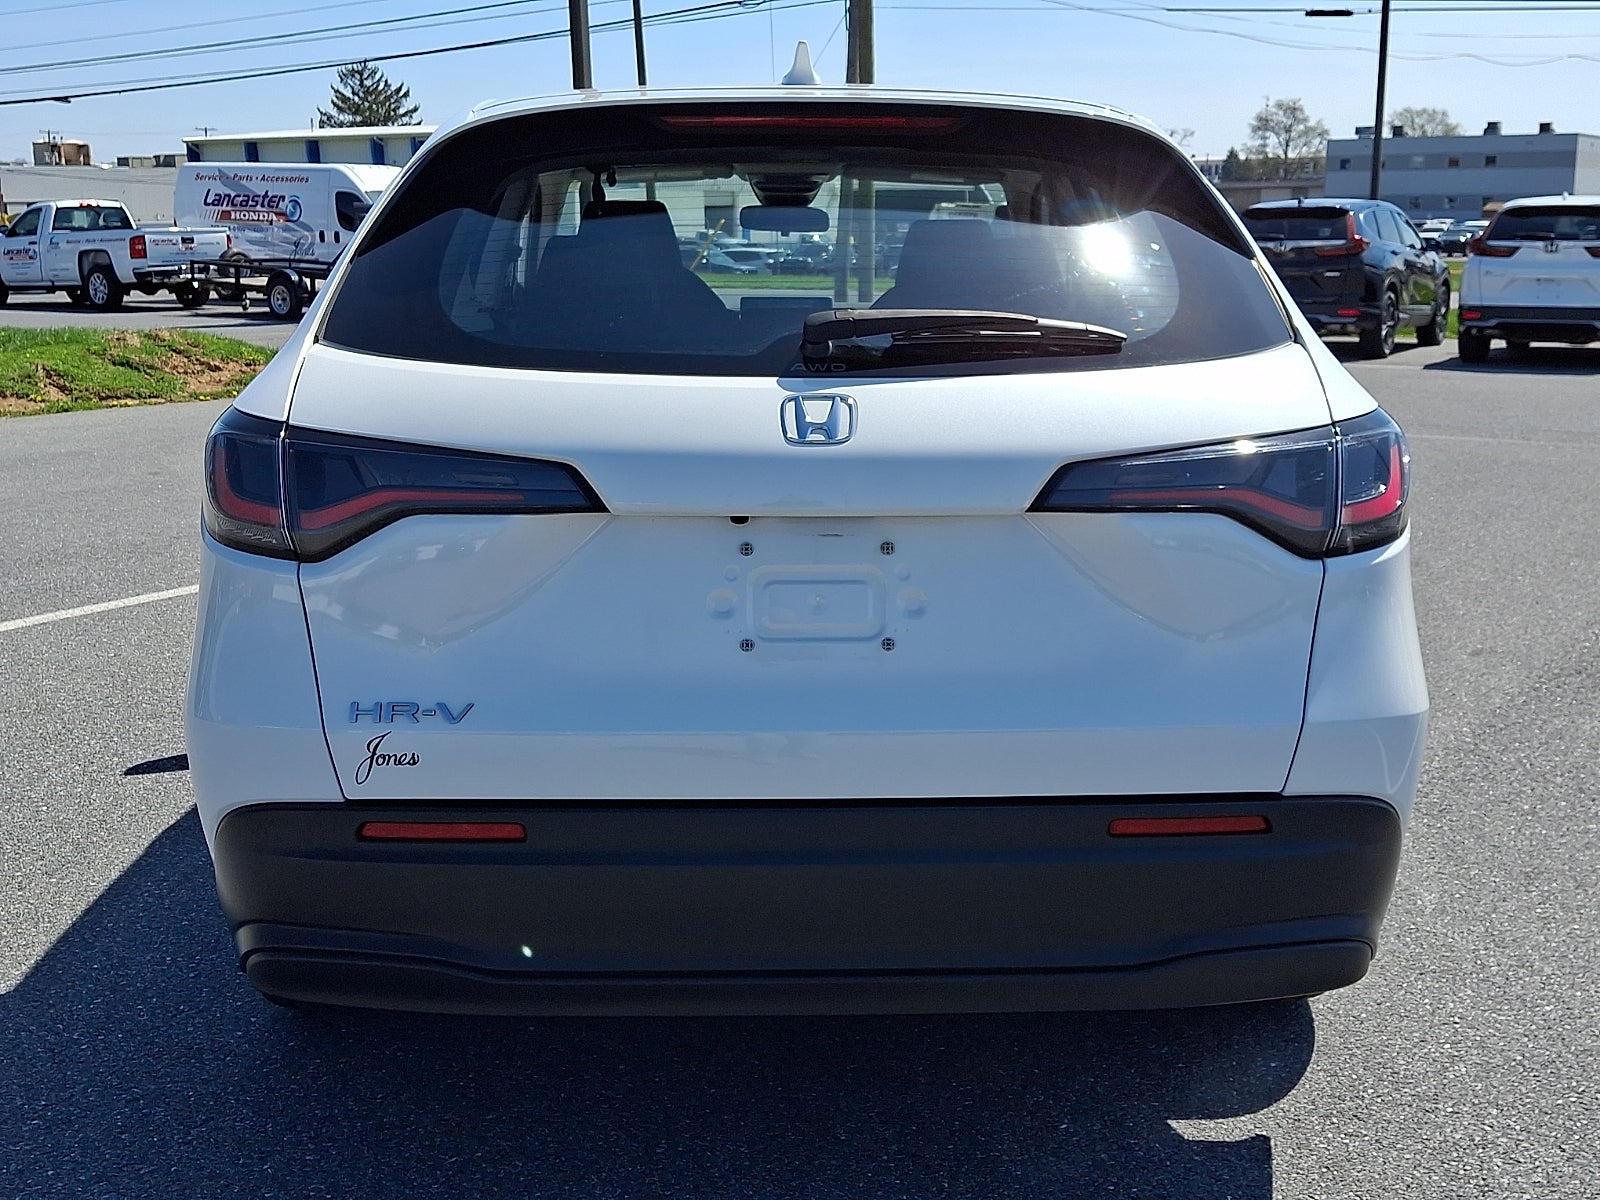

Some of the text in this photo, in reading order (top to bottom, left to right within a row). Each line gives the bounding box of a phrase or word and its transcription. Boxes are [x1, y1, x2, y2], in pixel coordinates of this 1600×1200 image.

[194, 171, 310, 184] Service Parts Accessories
[203, 188, 286, 210] Lancaster
[230, 210, 278, 222] HONDA
[790, 363, 846, 372] AWD
[349, 701, 475, 724] HR-V
[355, 730, 420, 785] Jones
